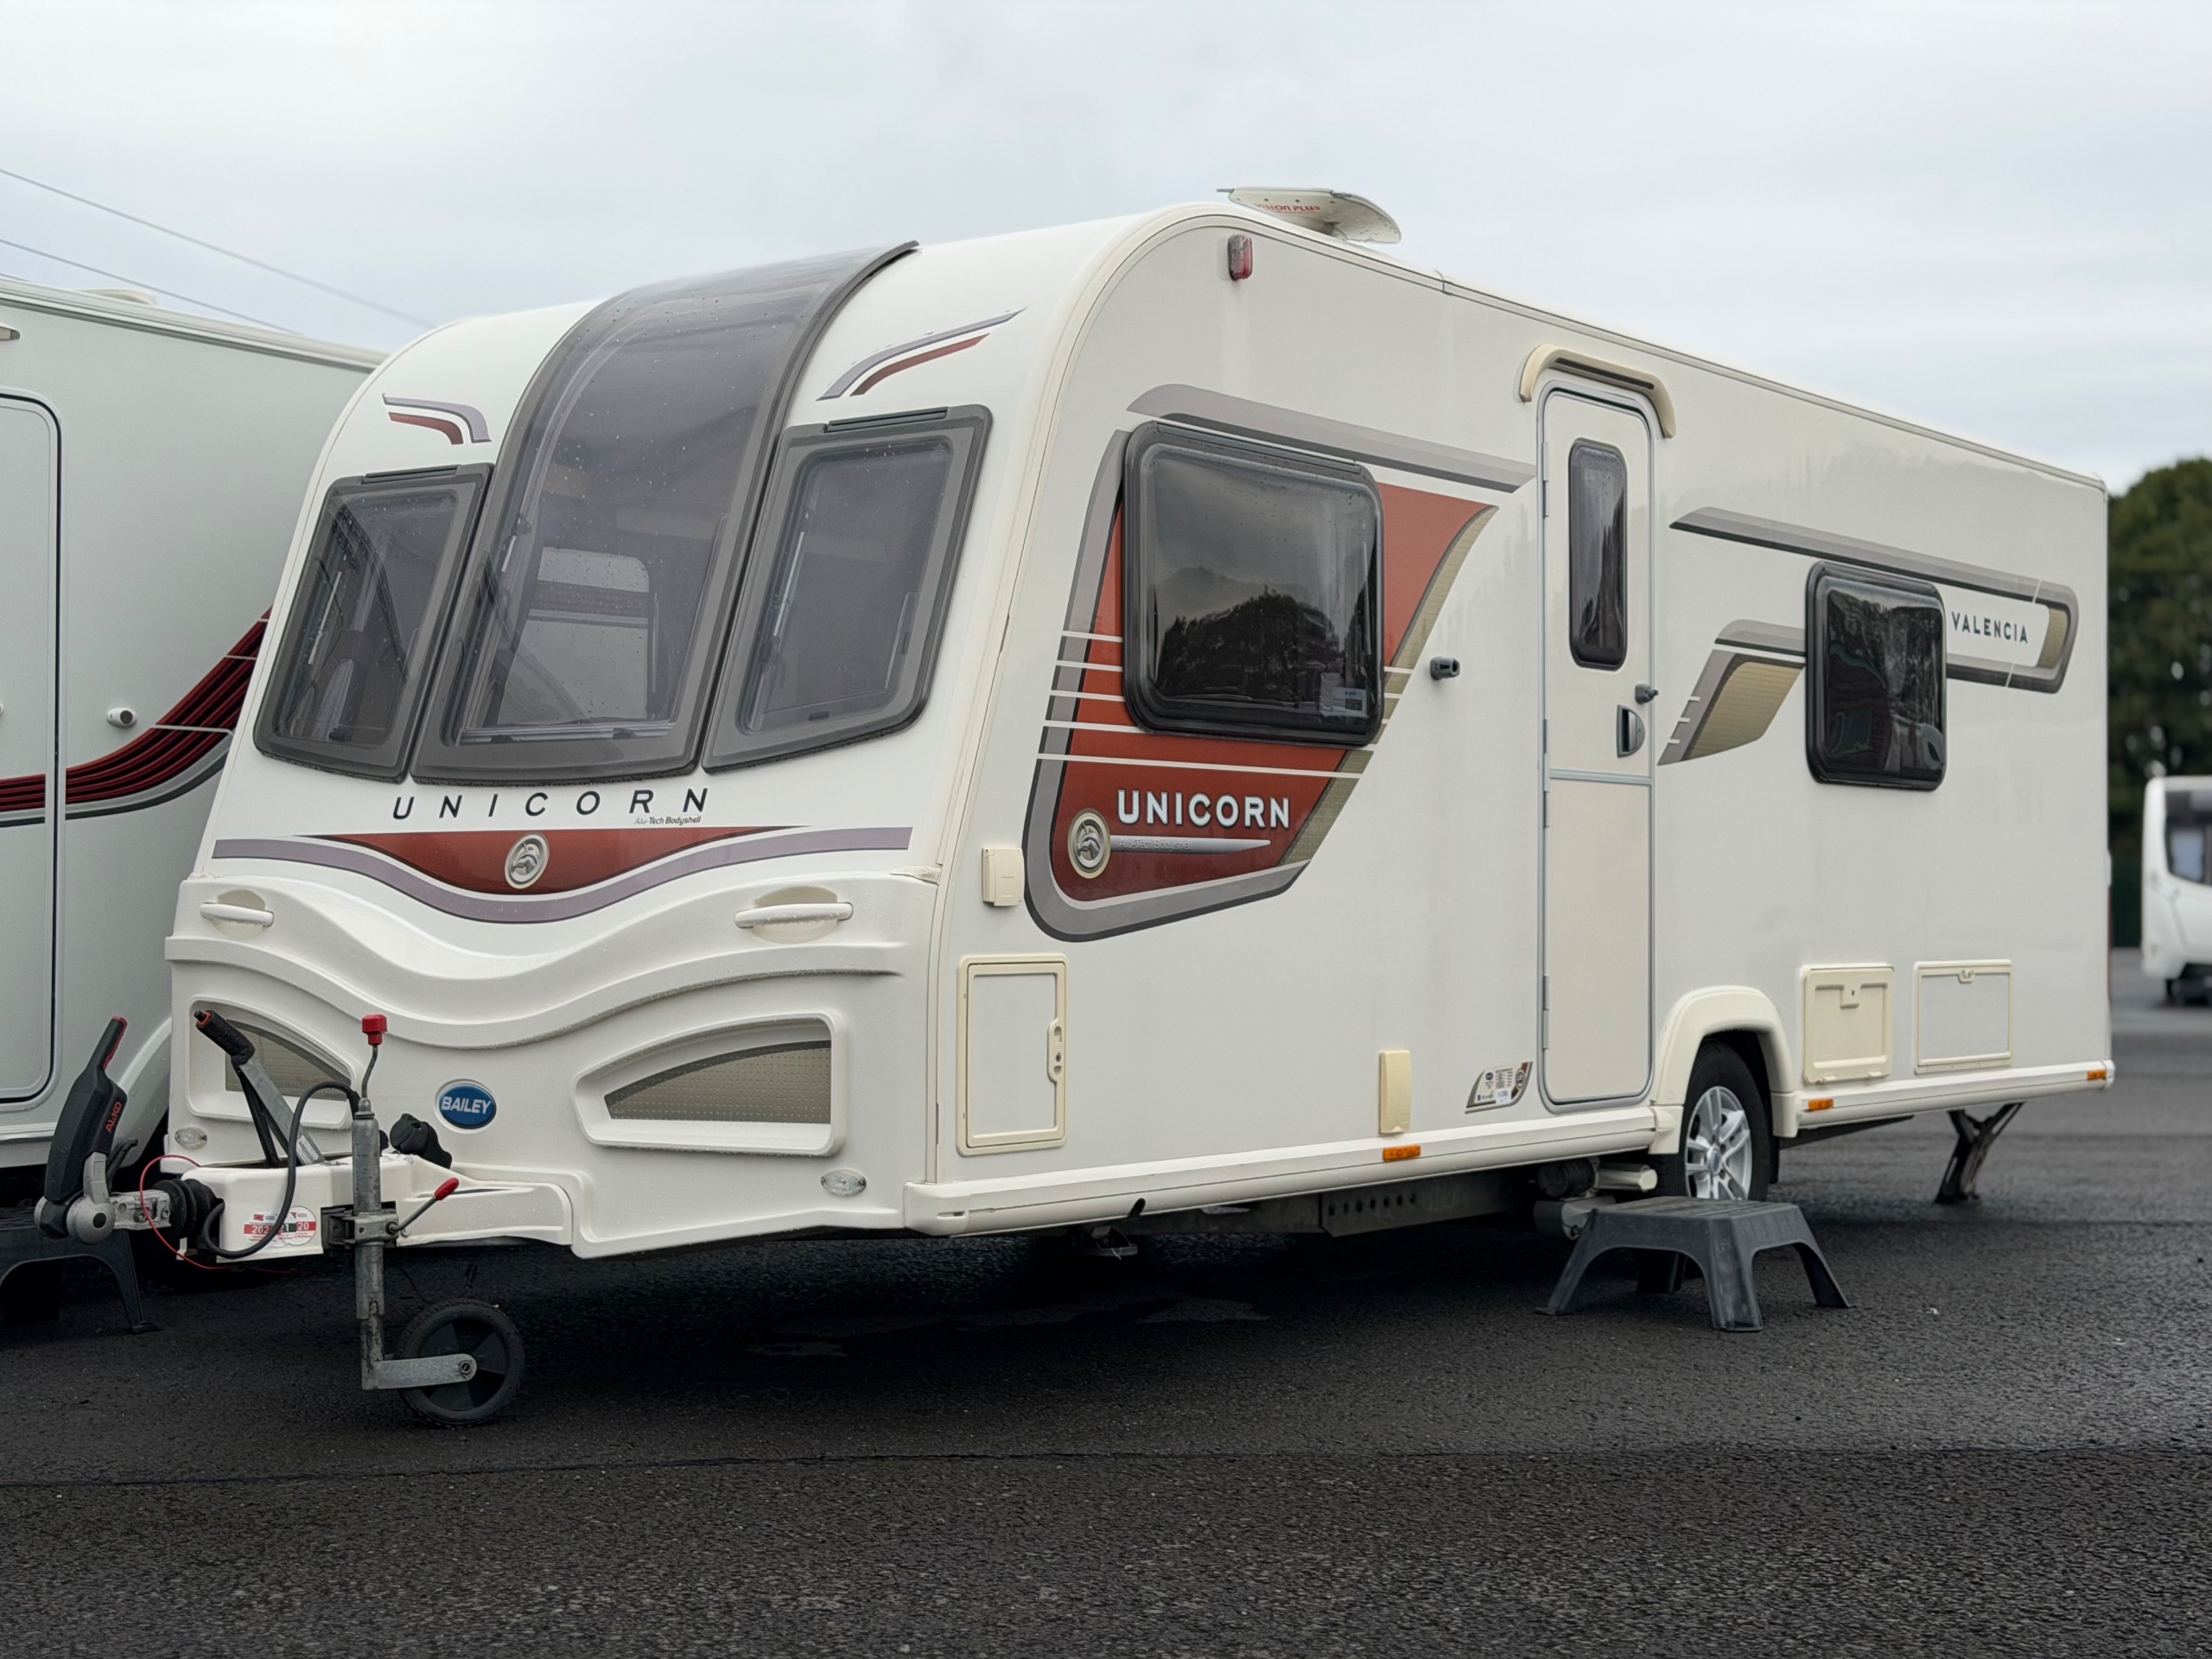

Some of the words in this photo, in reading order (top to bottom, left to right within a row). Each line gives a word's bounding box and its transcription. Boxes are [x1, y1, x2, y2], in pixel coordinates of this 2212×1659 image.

[1951, 611, 2028, 644] VALENCIA
[392, 787, 709, 820] UNICORN
[1118, 789, 1289, 829] UNICORN
[634, 817, 664, 825] Alu-Tech
[665, 816, 701, 826] Bodyshell
[441, 1096, 492, 1115] BAILEY
